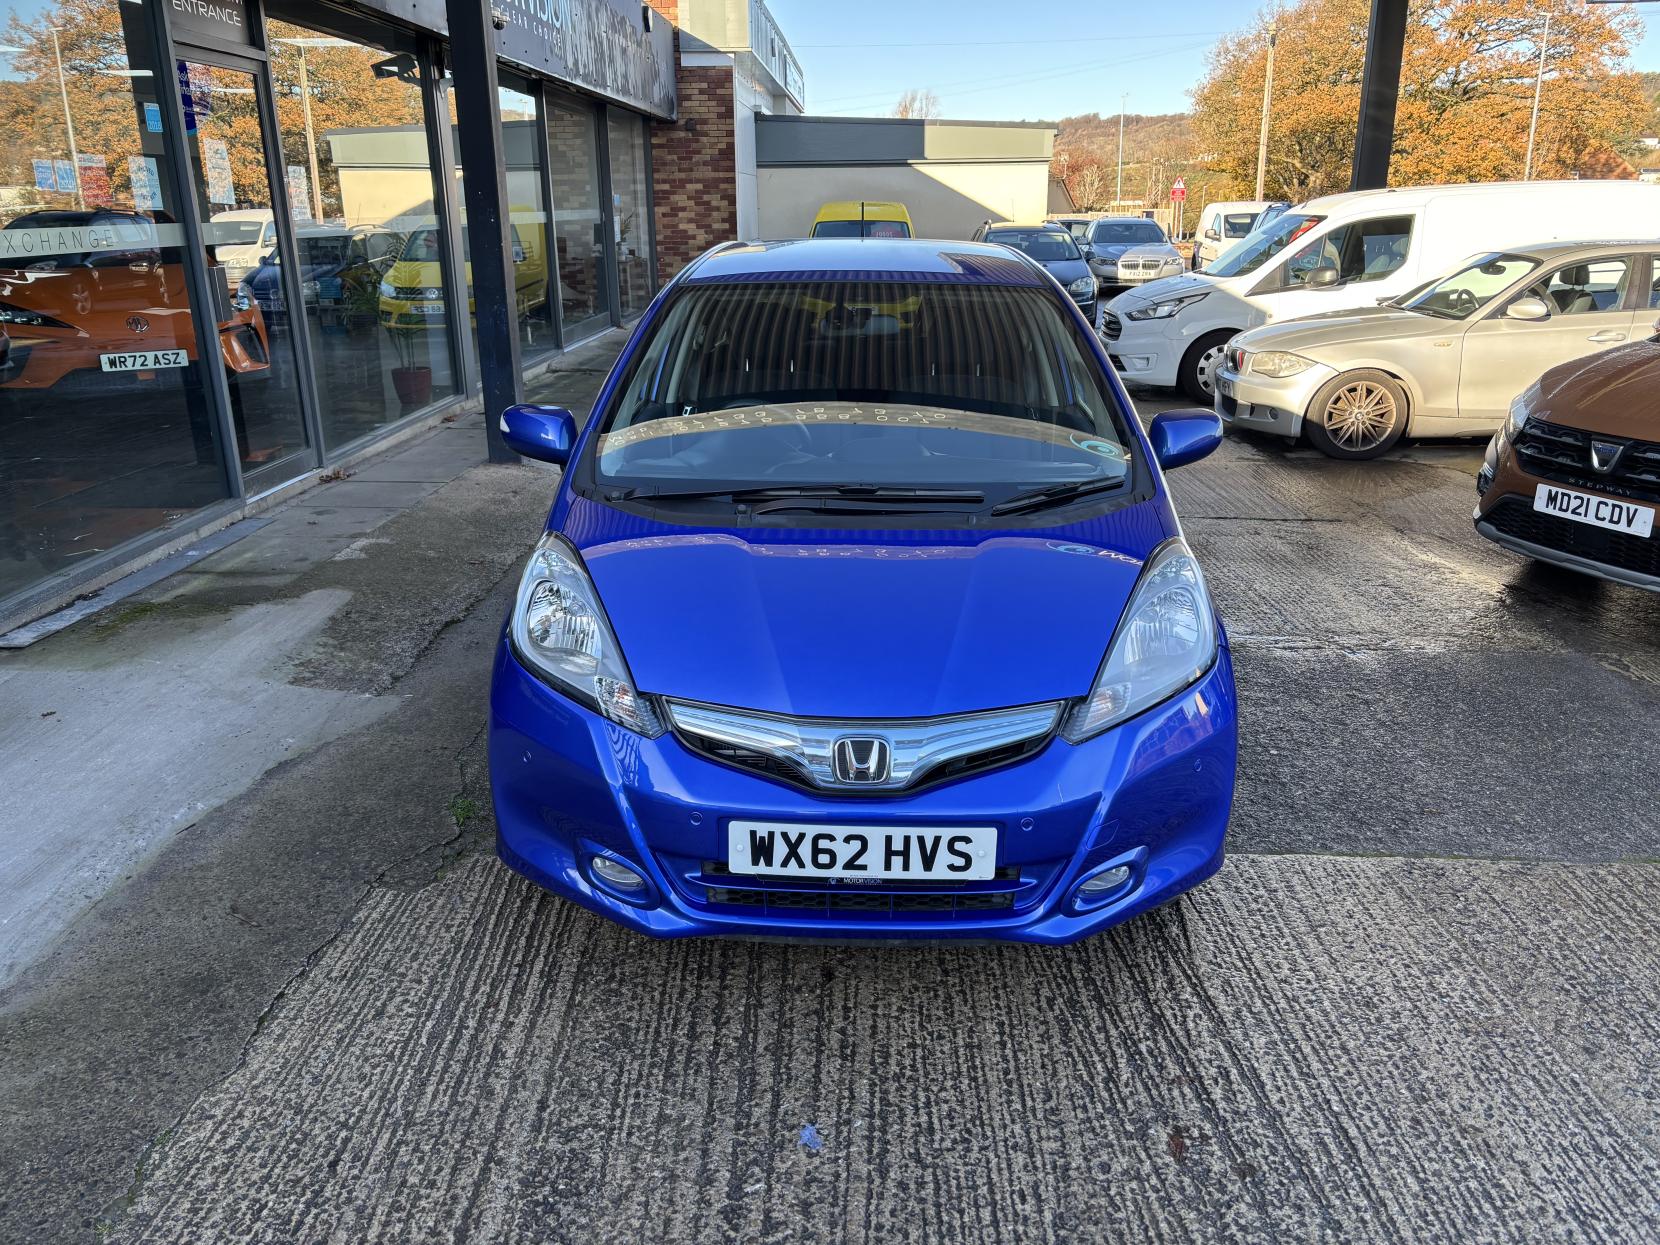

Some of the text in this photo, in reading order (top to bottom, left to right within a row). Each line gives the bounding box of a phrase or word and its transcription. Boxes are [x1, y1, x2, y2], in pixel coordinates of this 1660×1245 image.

[172, 0, 242, 27] ENTRANCE
[107, 352, 182, 369] WR72 ASZ
[1545, 488, 1639, 529] MD21 CDV
[749, 828, 974, 873] WX62 HVS
